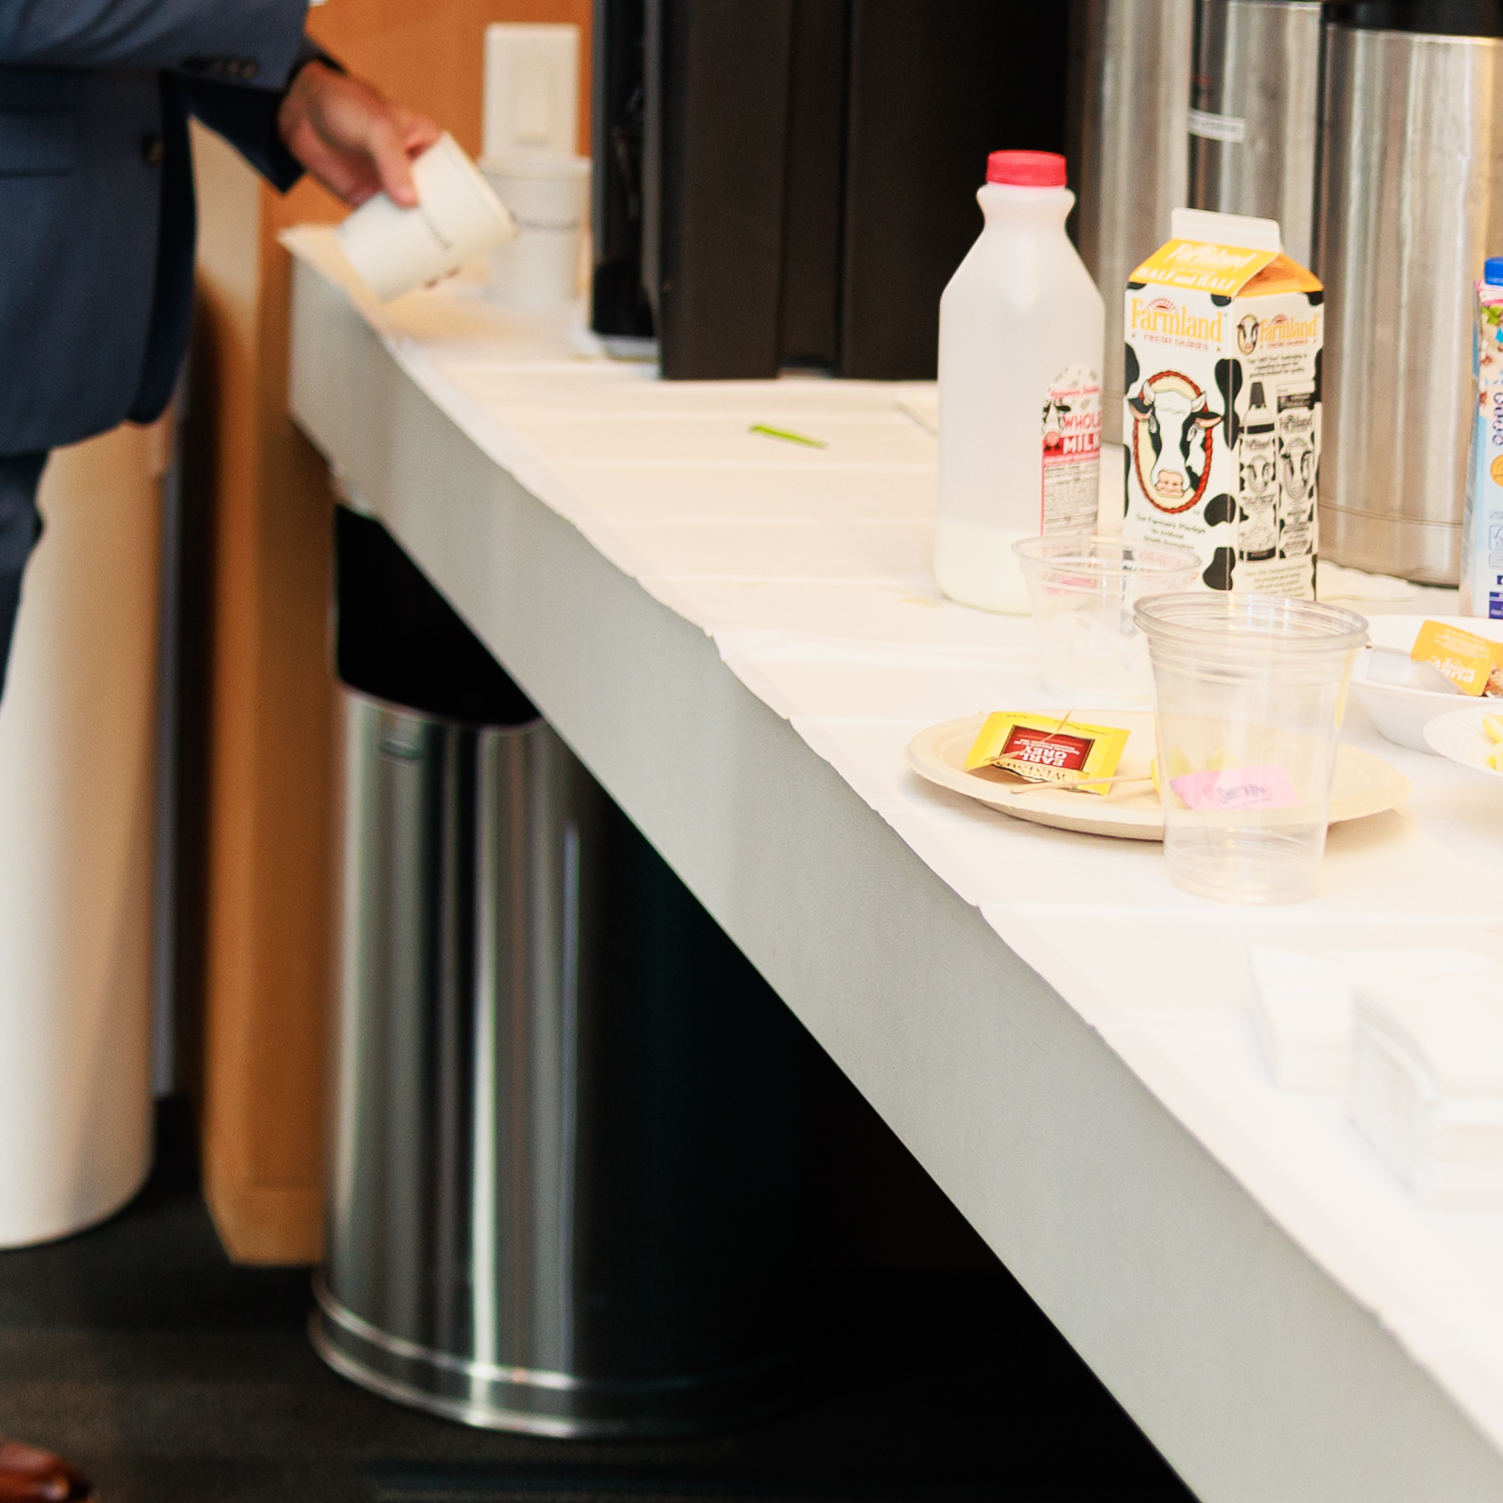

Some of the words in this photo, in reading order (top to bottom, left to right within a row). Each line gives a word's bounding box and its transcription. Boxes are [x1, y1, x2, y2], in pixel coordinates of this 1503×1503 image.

[1136, 266, 1176, 282] HALF
[1195, 275, 1237, 291] HALF
[1131, 298, 1222, 343] Farmland
[1260, 313, 1319, 342] Farmland
[1020, 753, 1065, 767] EARL
[1025, 745, 1068, 759] GREY
